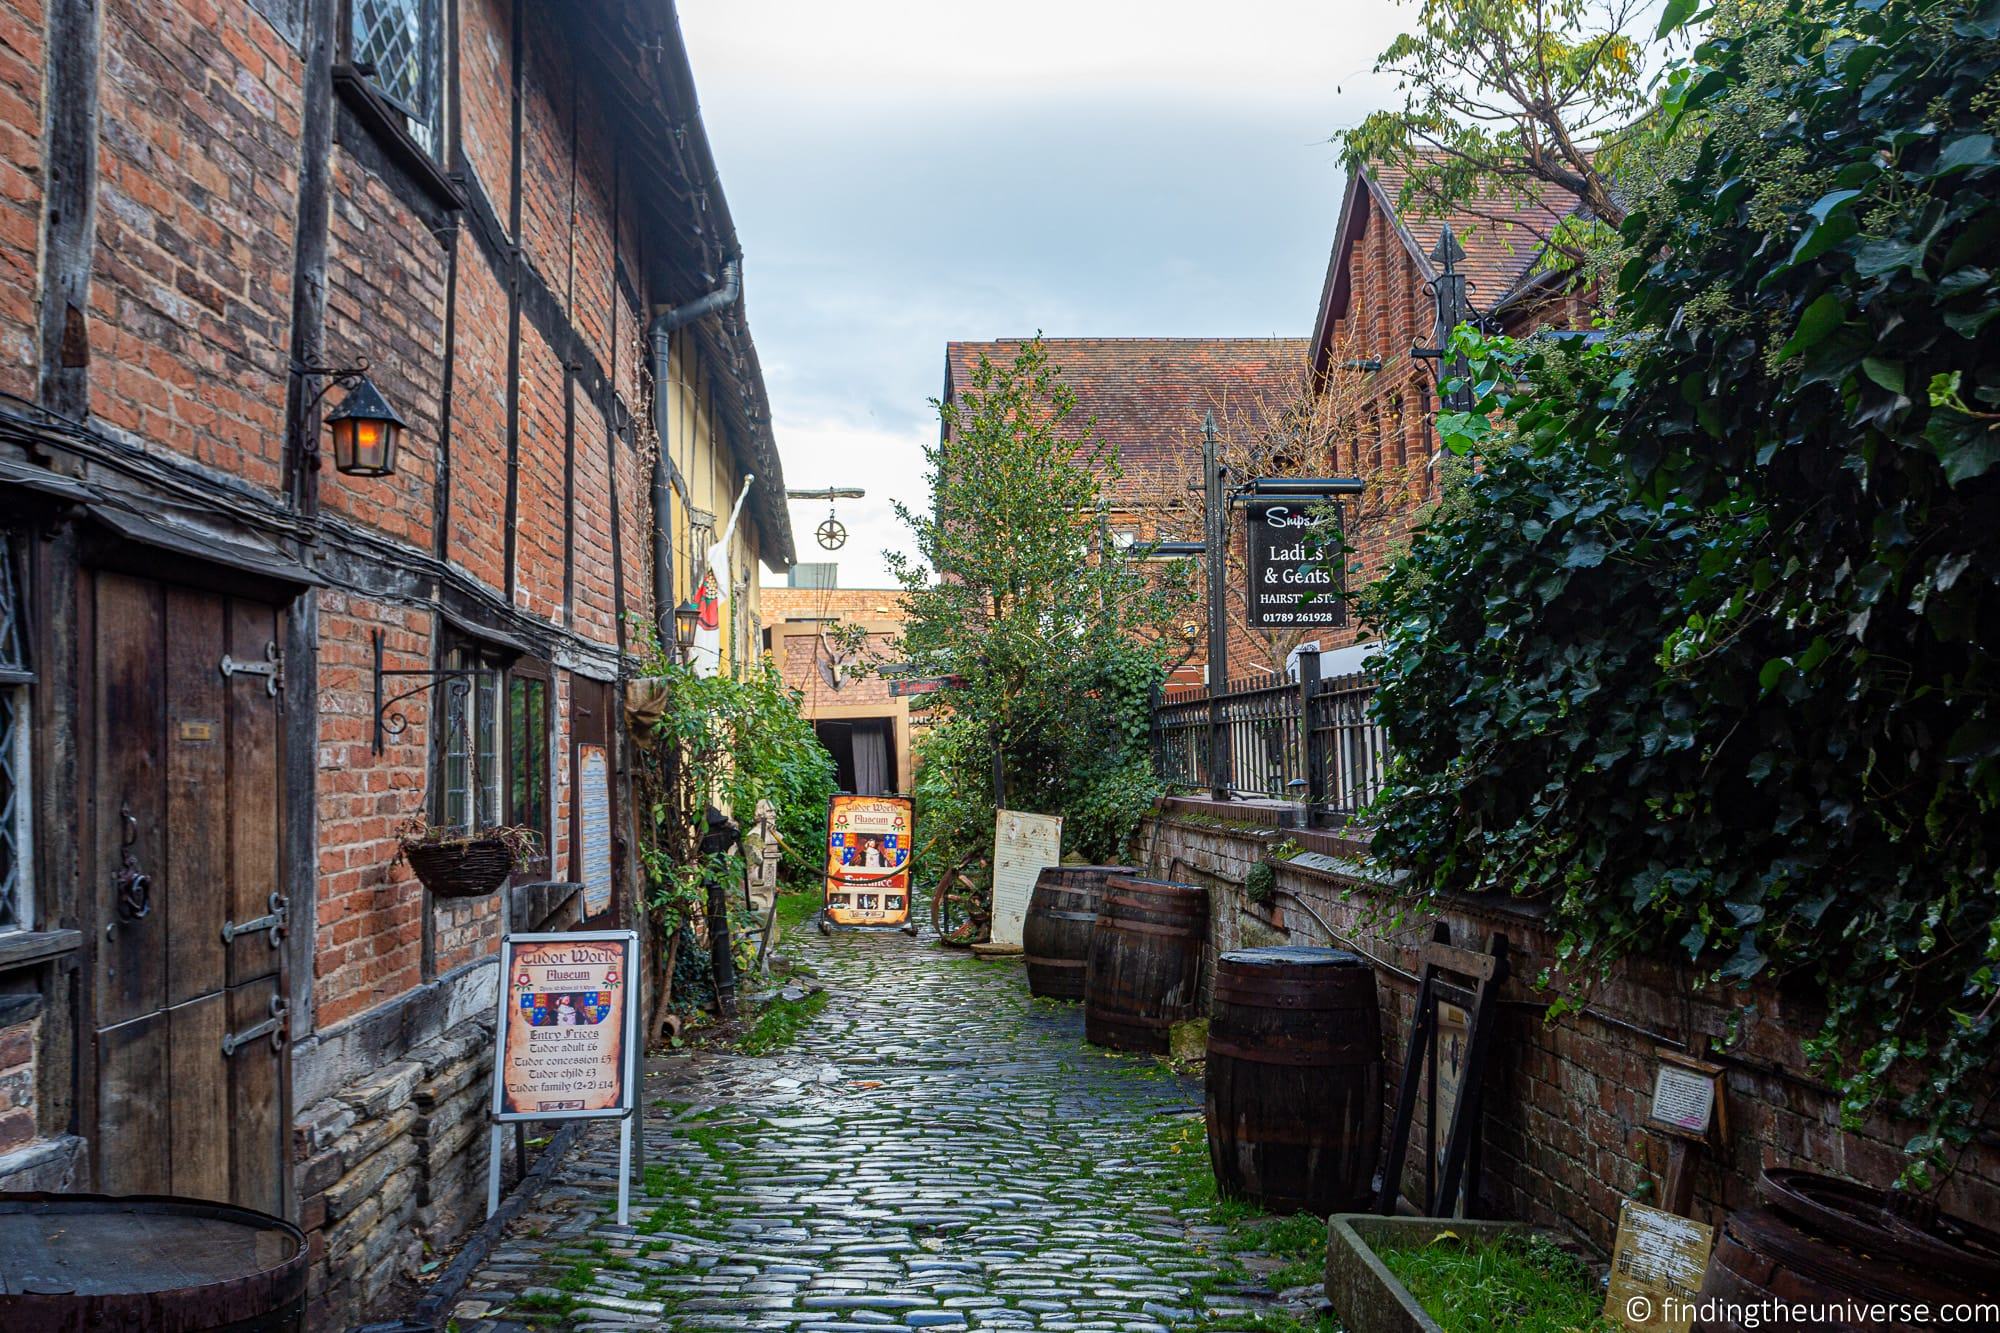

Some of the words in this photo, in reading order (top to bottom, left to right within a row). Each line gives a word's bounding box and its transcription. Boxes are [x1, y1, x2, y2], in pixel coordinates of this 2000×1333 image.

[1269, 542, 1324, 561] Ladis
[1264, 567, 1278, 584] &
[1282, 568, 1330, 584] Gents
[1263, 613, 1294, 622] 01789
[1296, 613, 1333, 622] 261928
[854, 815, 888, 824] Museum
[521, 950, 567, 964] Tudor
[571, 948, 617, 963] World
[546, 969, 590, 980] Museum
[529, 1029, 561, 1041] Entry
[564, 1028, 599, 1040] Prices
[529, 1043, 559, 1053] Tudor
[561, 1042, 585, 1052] adult
[514, 1057, 543, 1067] Tudor
[546, 1056, 599, 1066] concession
[528, 1069, 558, 1079] Tudor
[560, 1068, 584, 1079] child
[509, 1083, 538, 1093] Tudor
[541, 1081, 571, 1093] family
[598, 1080, 614, 1089] £14
